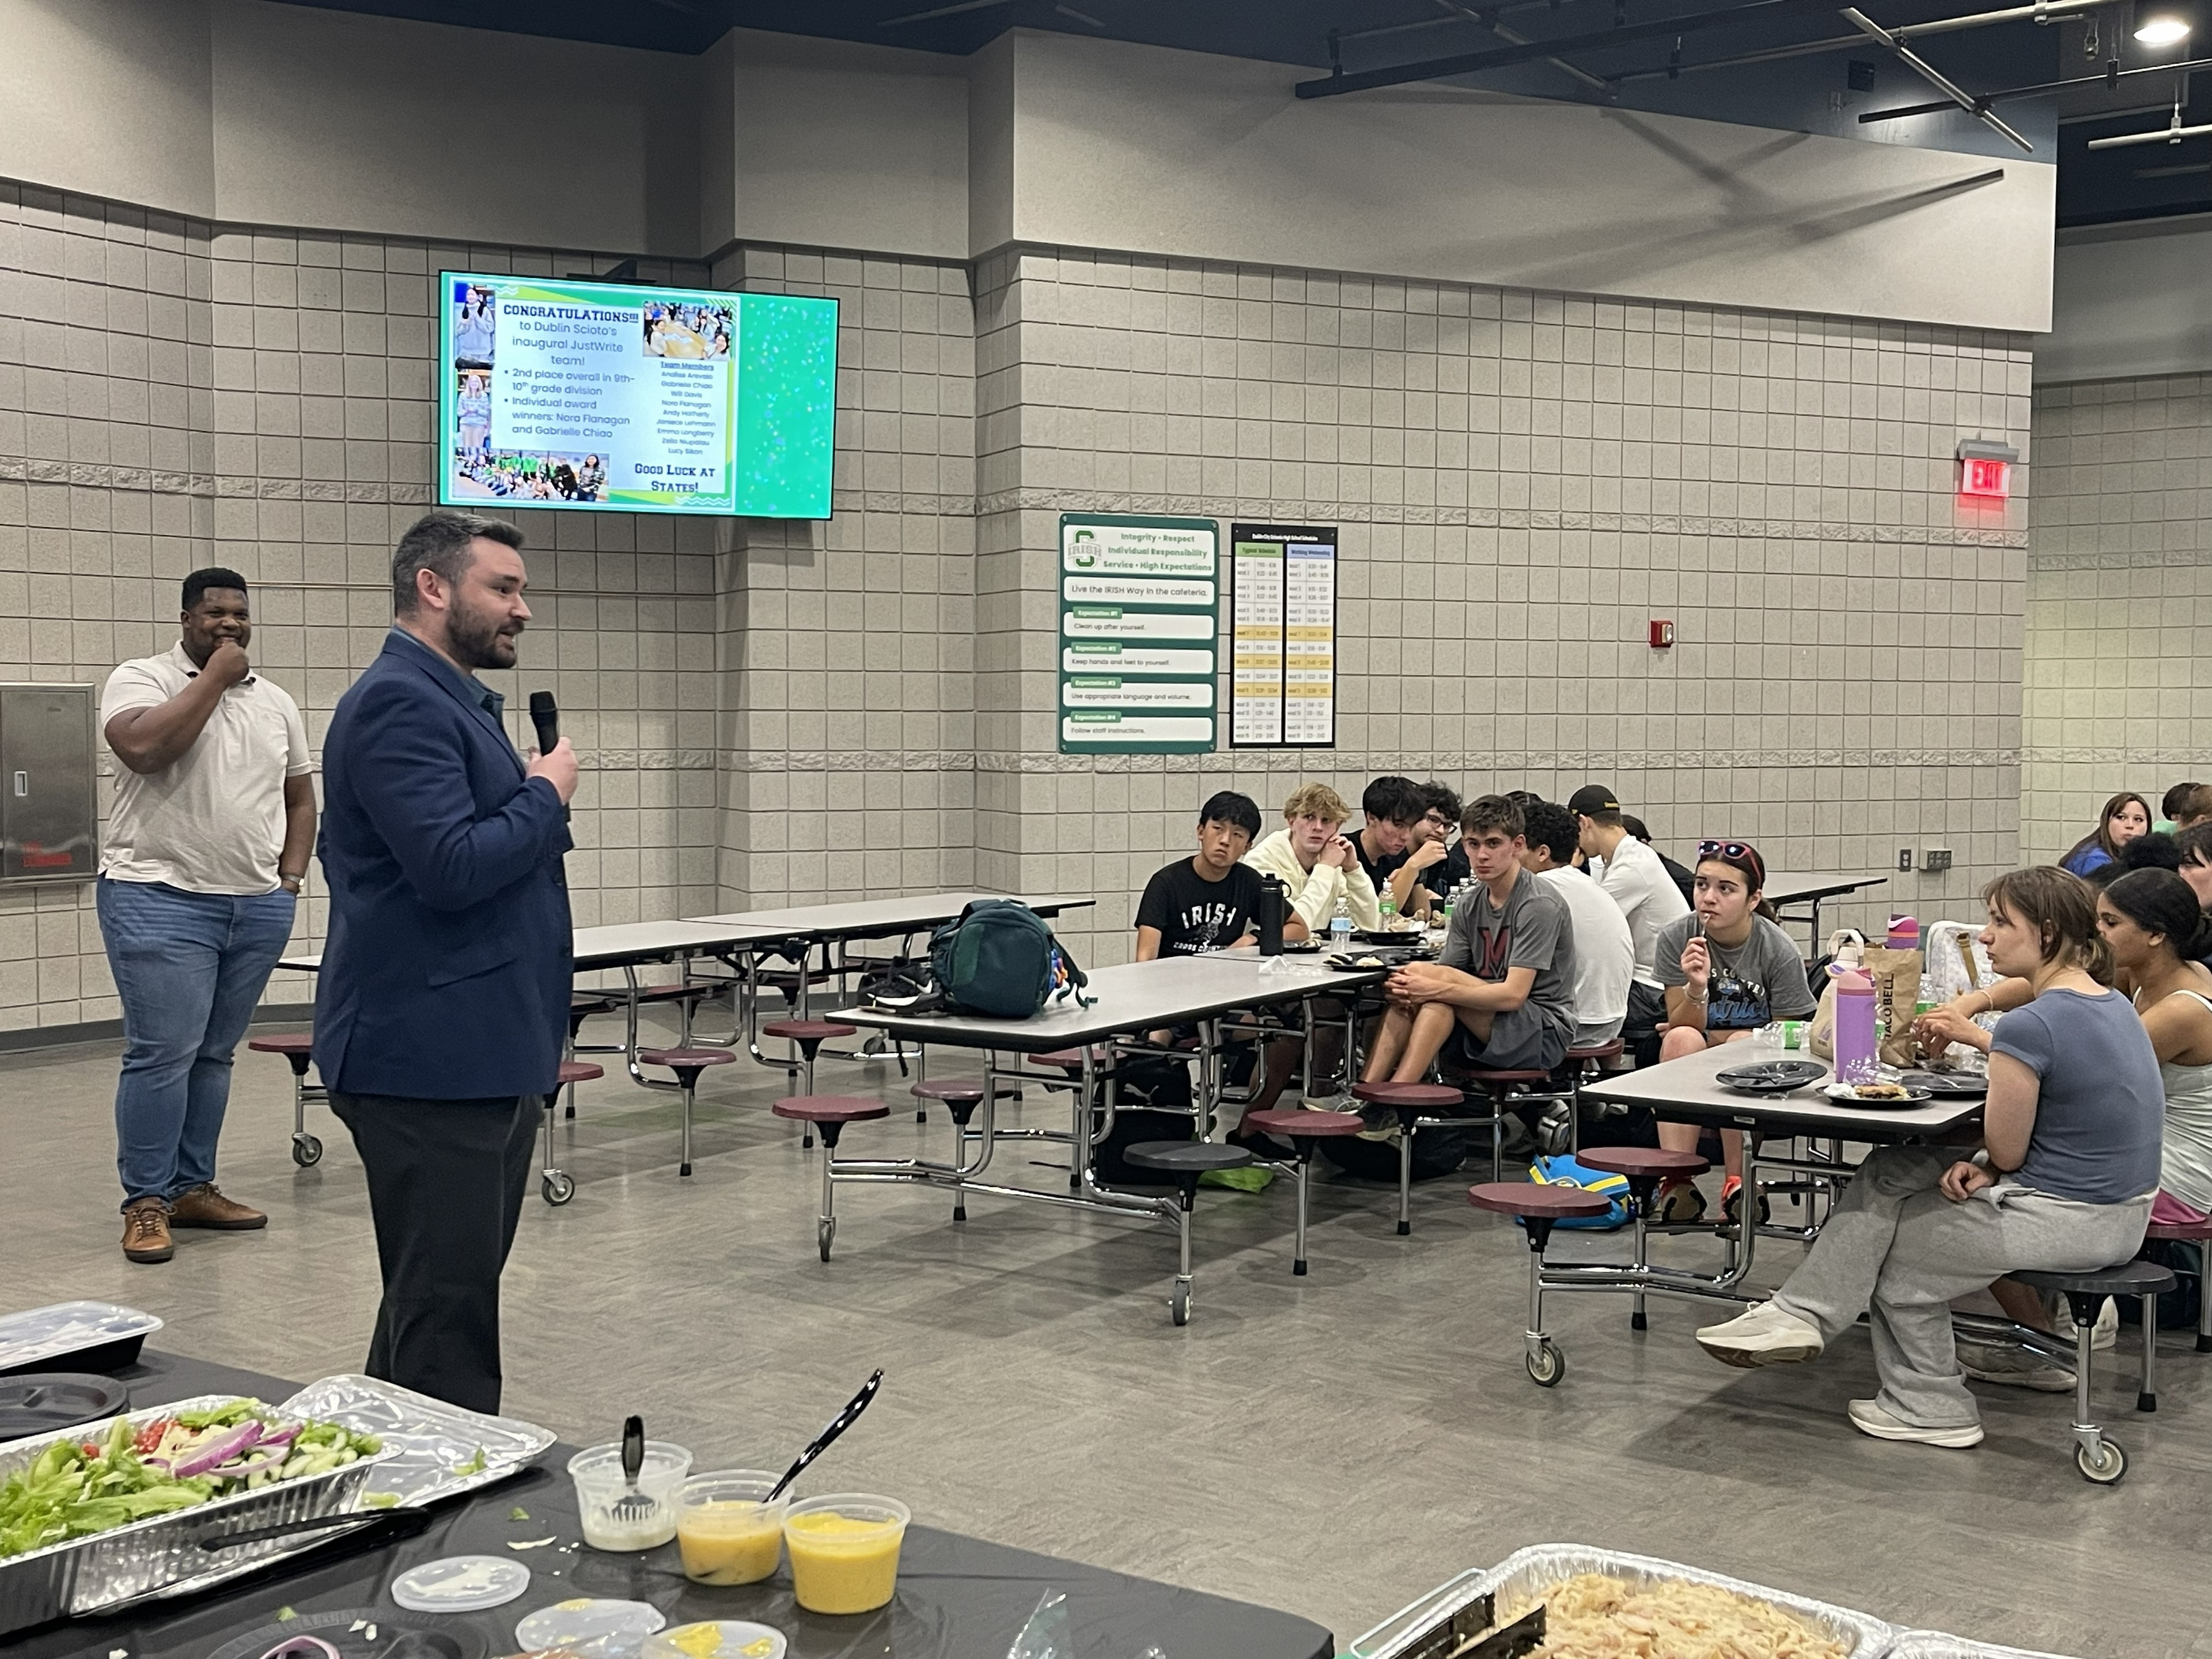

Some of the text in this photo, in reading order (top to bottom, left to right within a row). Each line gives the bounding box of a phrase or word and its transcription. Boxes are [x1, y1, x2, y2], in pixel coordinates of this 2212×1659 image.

[520, 321, 617, 336] to Dublin Scioto's
[513, 336, 623, 352] inaugural JustWrite
[551, 355, 585, 366] team!
[513, 369, 532, 377] 2nd
[535, 371, 563, 380] place
[566, 373, 600, 381] overall
[603, 373, 611, 382] in
[531, 384, 562, 394] grade
[565, 385, 602, 395] division
[513, 397, 597, 409] Individual award
[512, 411, 630, 426] winners: Nora Flanagan
[535, 426, 580, 436] Gabrielle
[583, 428, 612, 437] Chiao
[1121, 533, 1195, 544] Integrity Respect
[1067, 544, 1102, 558] IRISH
[1151, 548, 1207, 559] Responsibility
[1140, 562, 1159, 571] High
[1160, 563, 1211, 572] Expectations
[1127, 588, 1145, 596] Way
[1171, 588, 1207, 597] cafeteria.
